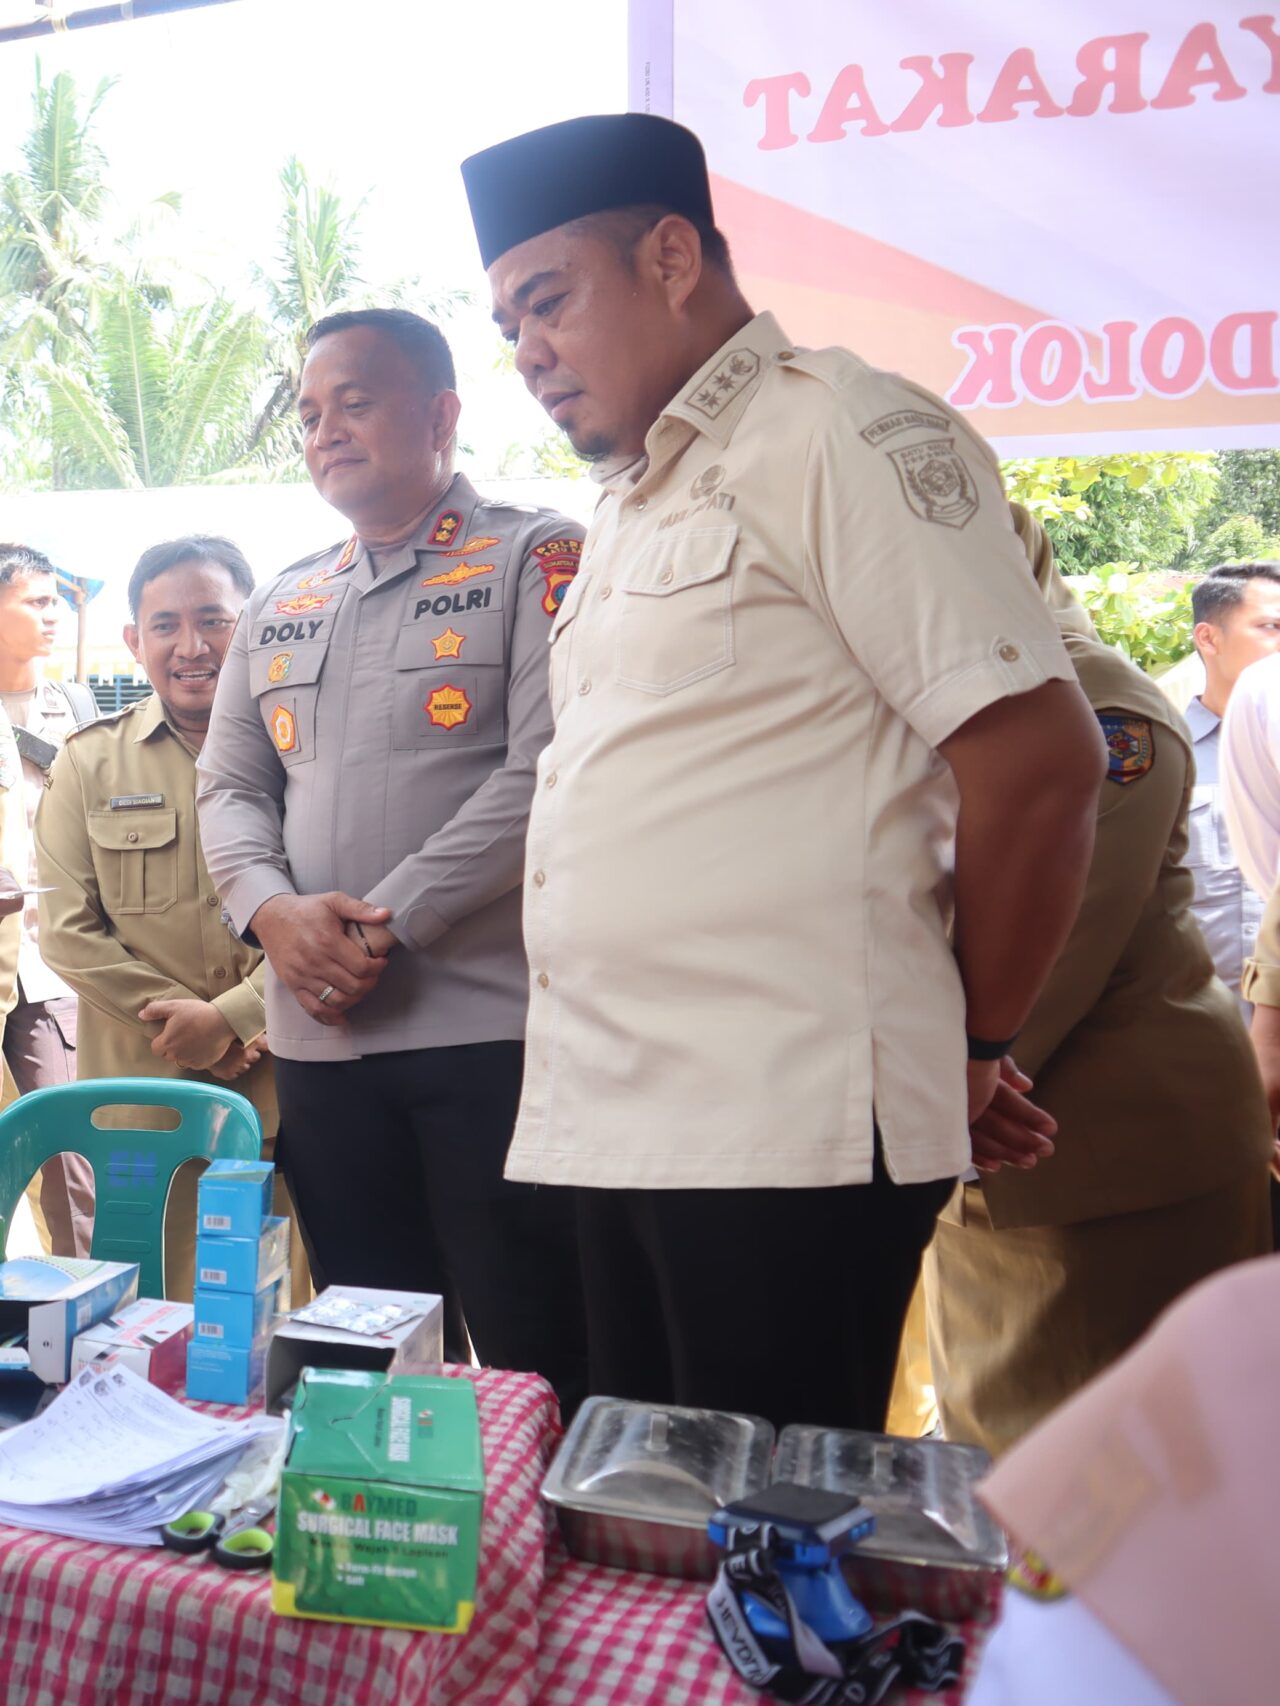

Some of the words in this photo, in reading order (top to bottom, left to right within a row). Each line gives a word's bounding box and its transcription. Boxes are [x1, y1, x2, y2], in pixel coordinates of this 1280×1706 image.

[414, 587, 492, 620] POLRI
[260, 620, 324, 645] DOLY
[297, 1511, 372, 1540] SURGICAL
[374, 1520, 411, 1542] FACE
[413, 1523, 459, 1546] MASK
